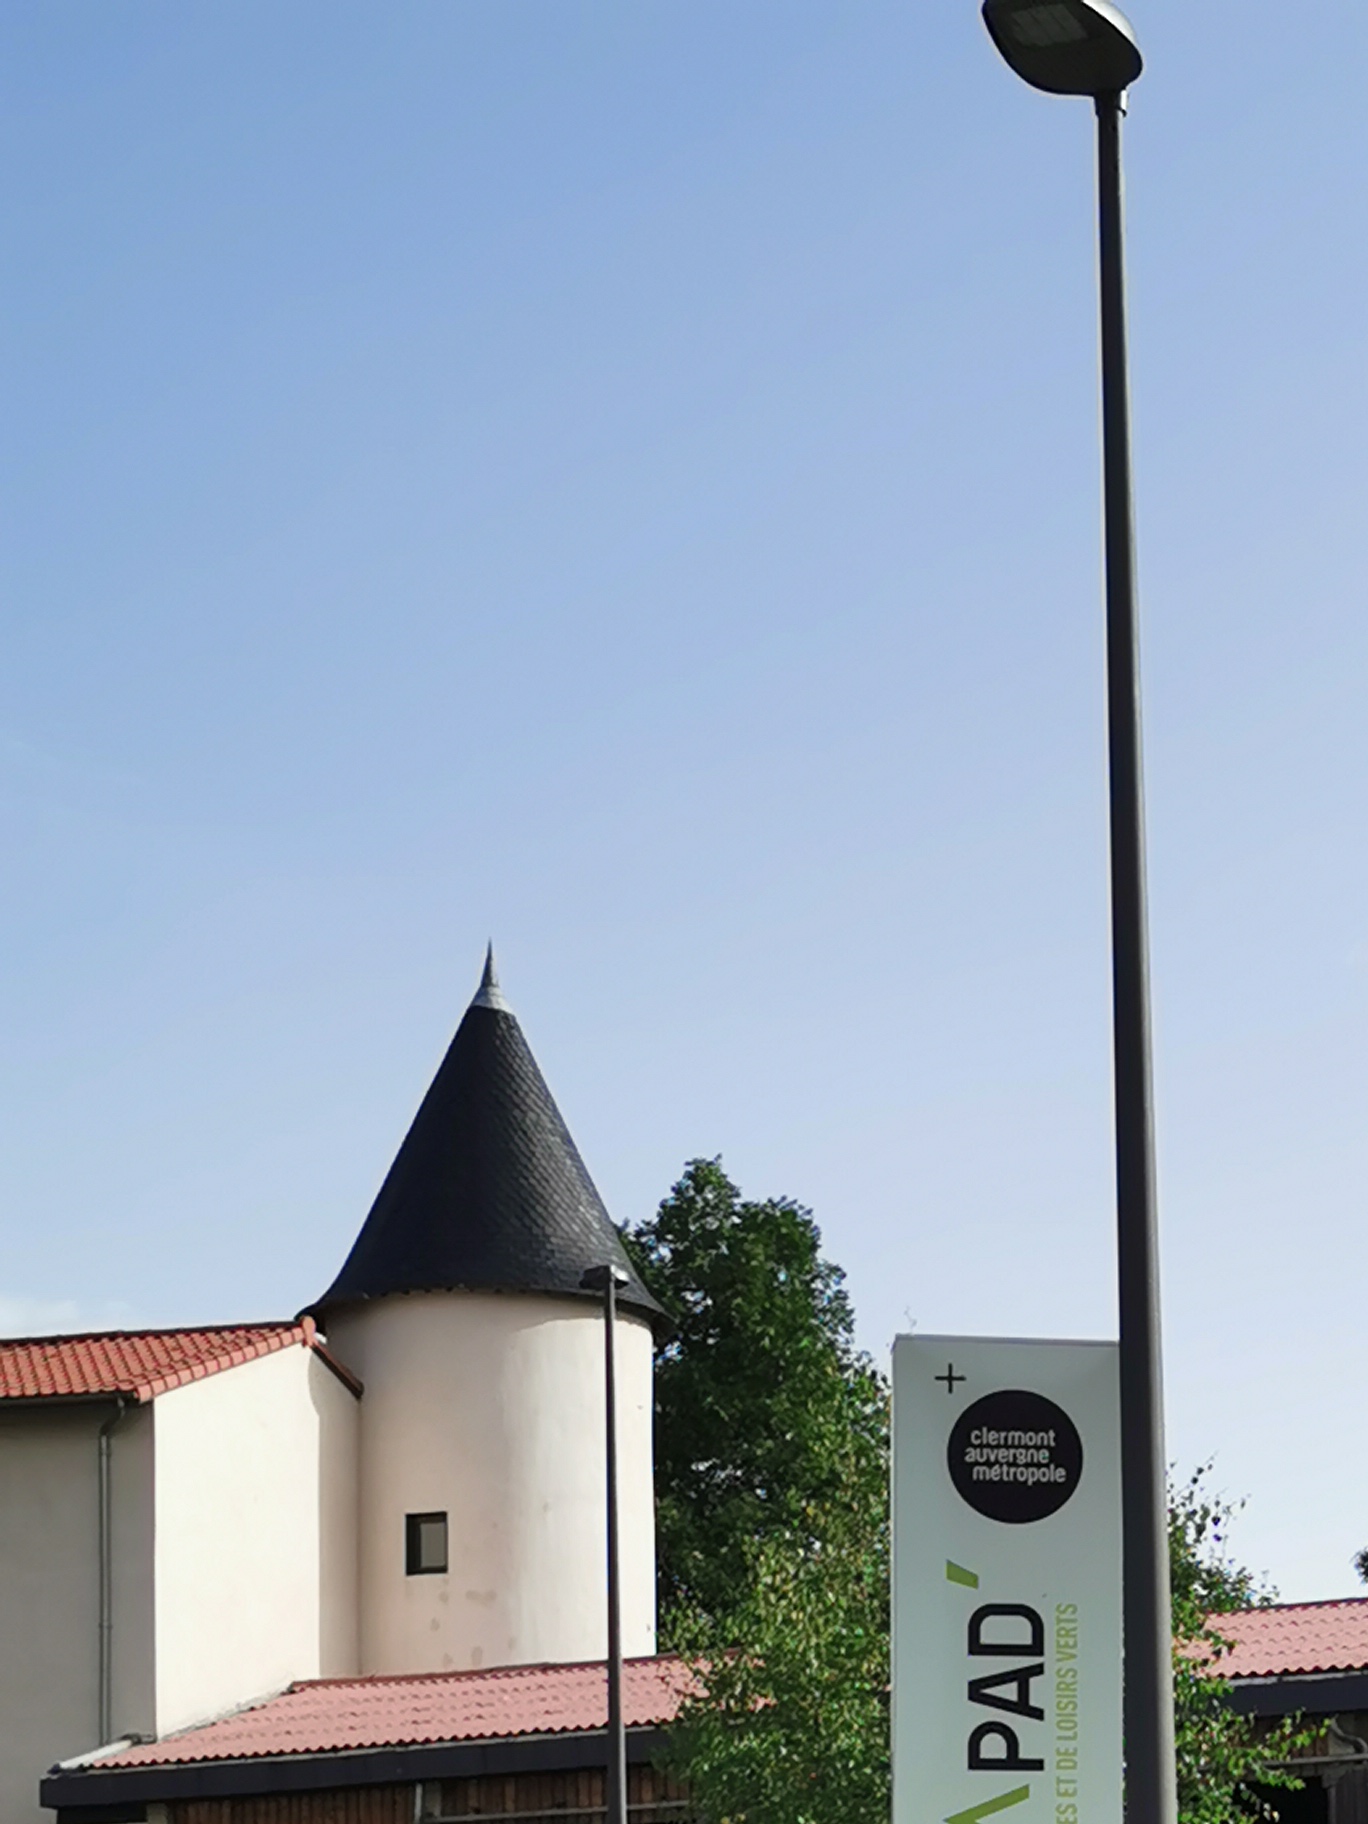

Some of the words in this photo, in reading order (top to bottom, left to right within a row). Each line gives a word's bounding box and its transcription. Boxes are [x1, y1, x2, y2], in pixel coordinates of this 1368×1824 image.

[970, 1427, 1056, 1447] clermont
[964, 1447, 1050, 1465] auvergne
[971, 1463, 1067, 1486] métropole
[1055, 1602, 1078, 1663] VERTS
[1055, 1667, 1078, 1742] LOISIRS
[1055, 1747, 1078, 1771] DE
[1055, 1776, 1078, 1798] ET
